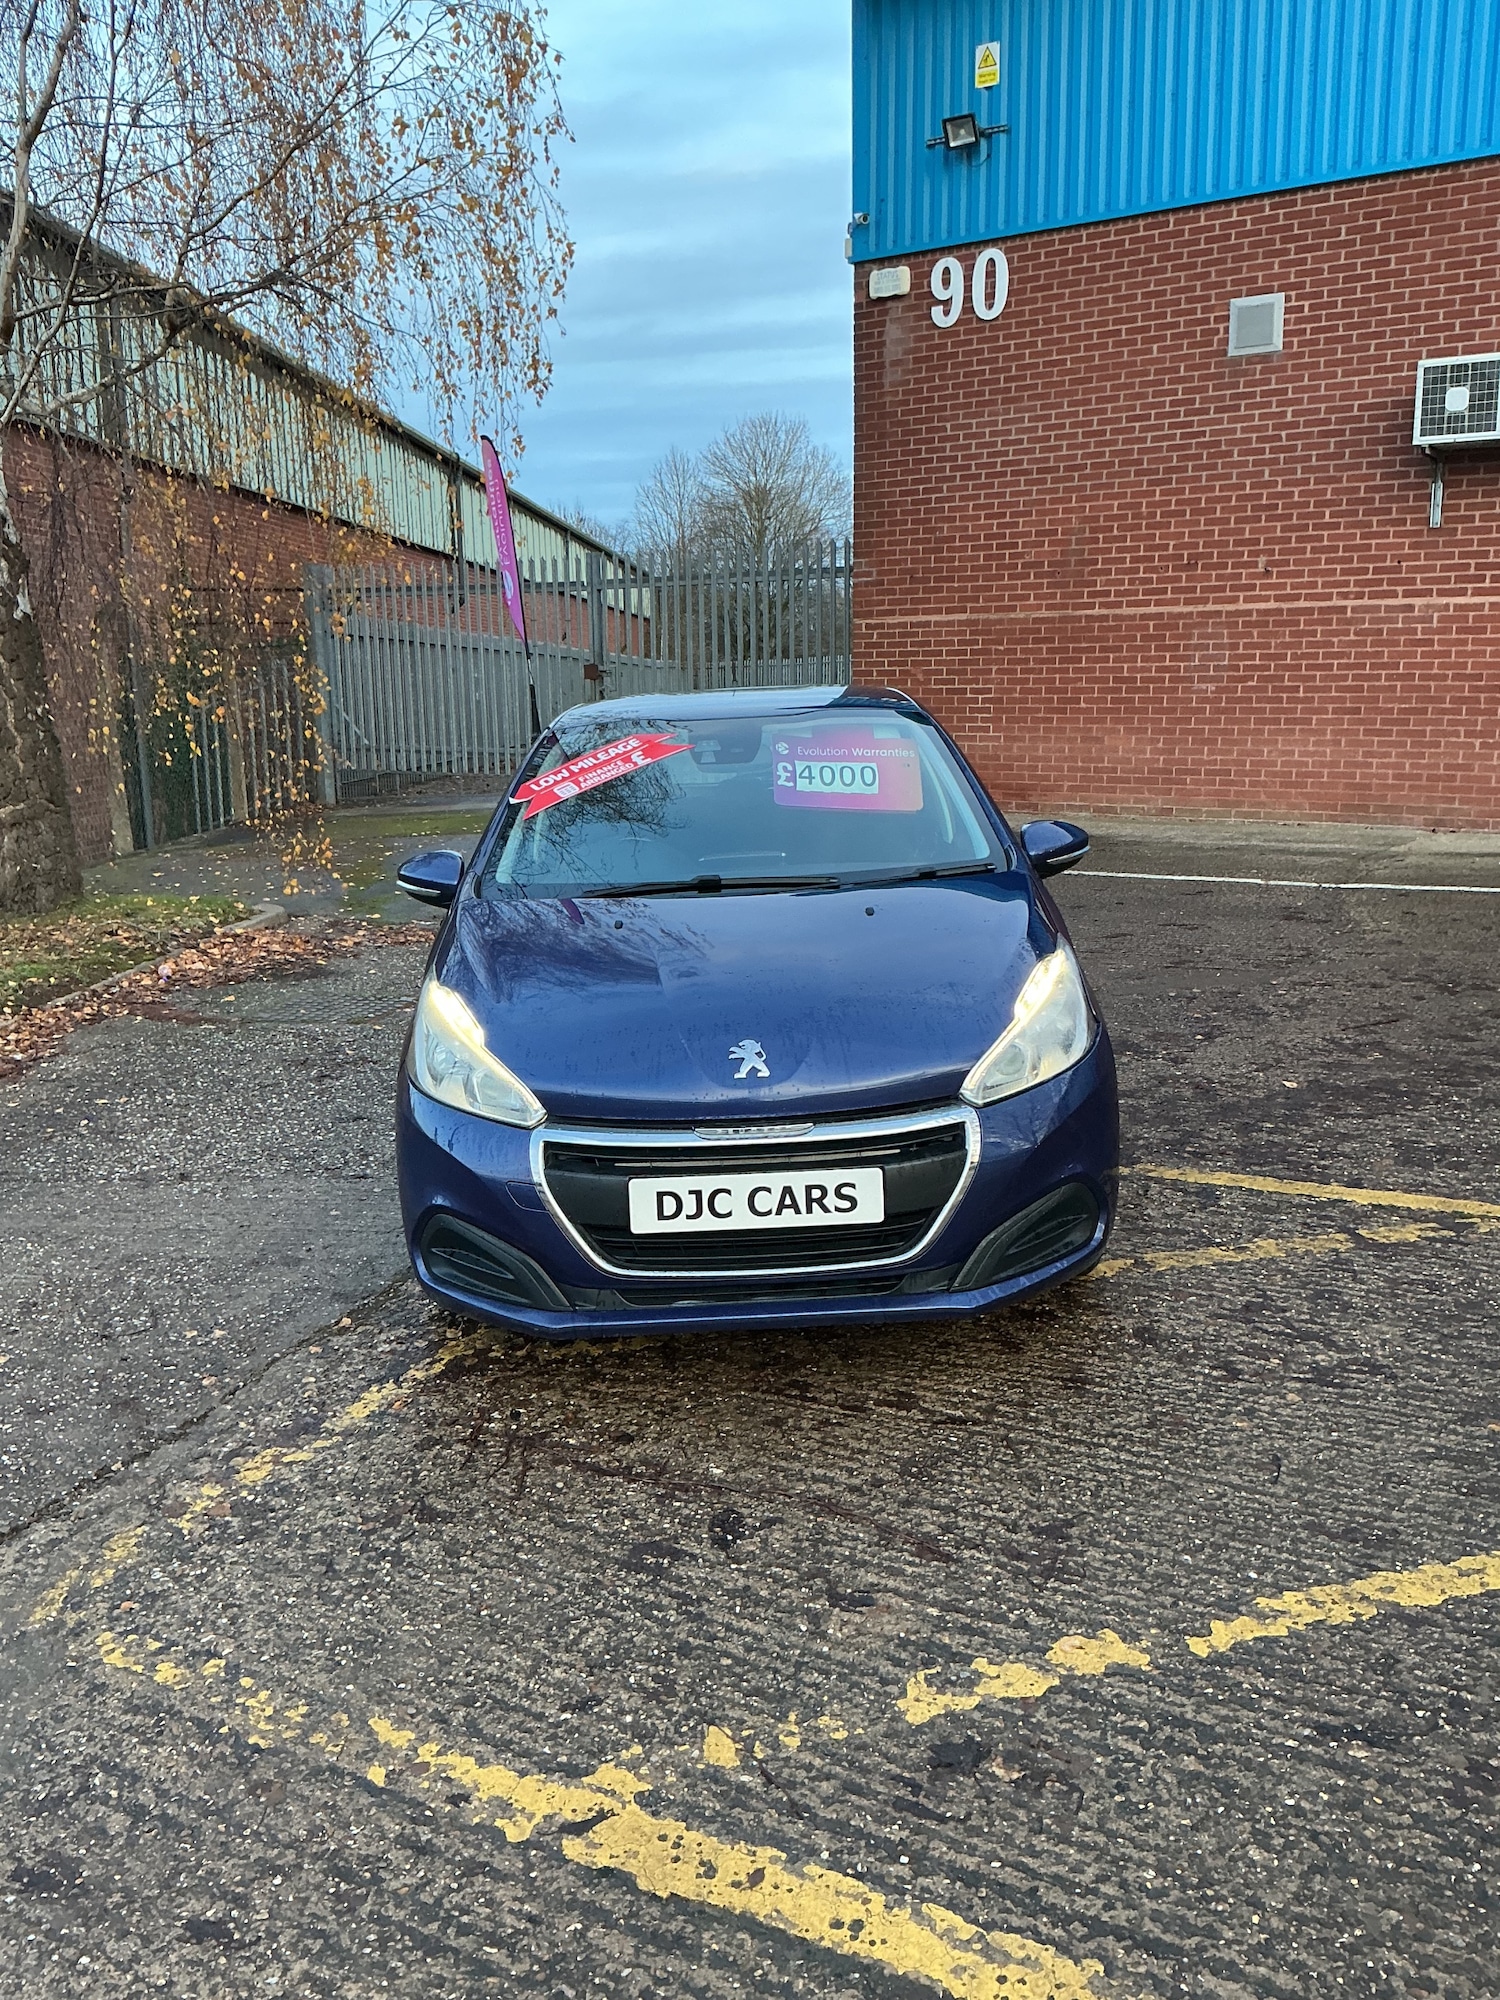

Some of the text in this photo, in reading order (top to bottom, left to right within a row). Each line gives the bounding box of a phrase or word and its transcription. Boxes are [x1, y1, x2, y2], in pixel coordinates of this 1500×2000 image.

[876, 269, 899, 280] STATUS
[930, 248, 1009, 328] 90
[530, 738, 643, 791] LOW MILEAGE
[797, 746, 916, 758] Evolution Warranties
[578, 759, 625, 783] FINANCE
[579, 762, 635, 789] ARRANGED
[655, 1182, 858, 1222] DJC CARS
